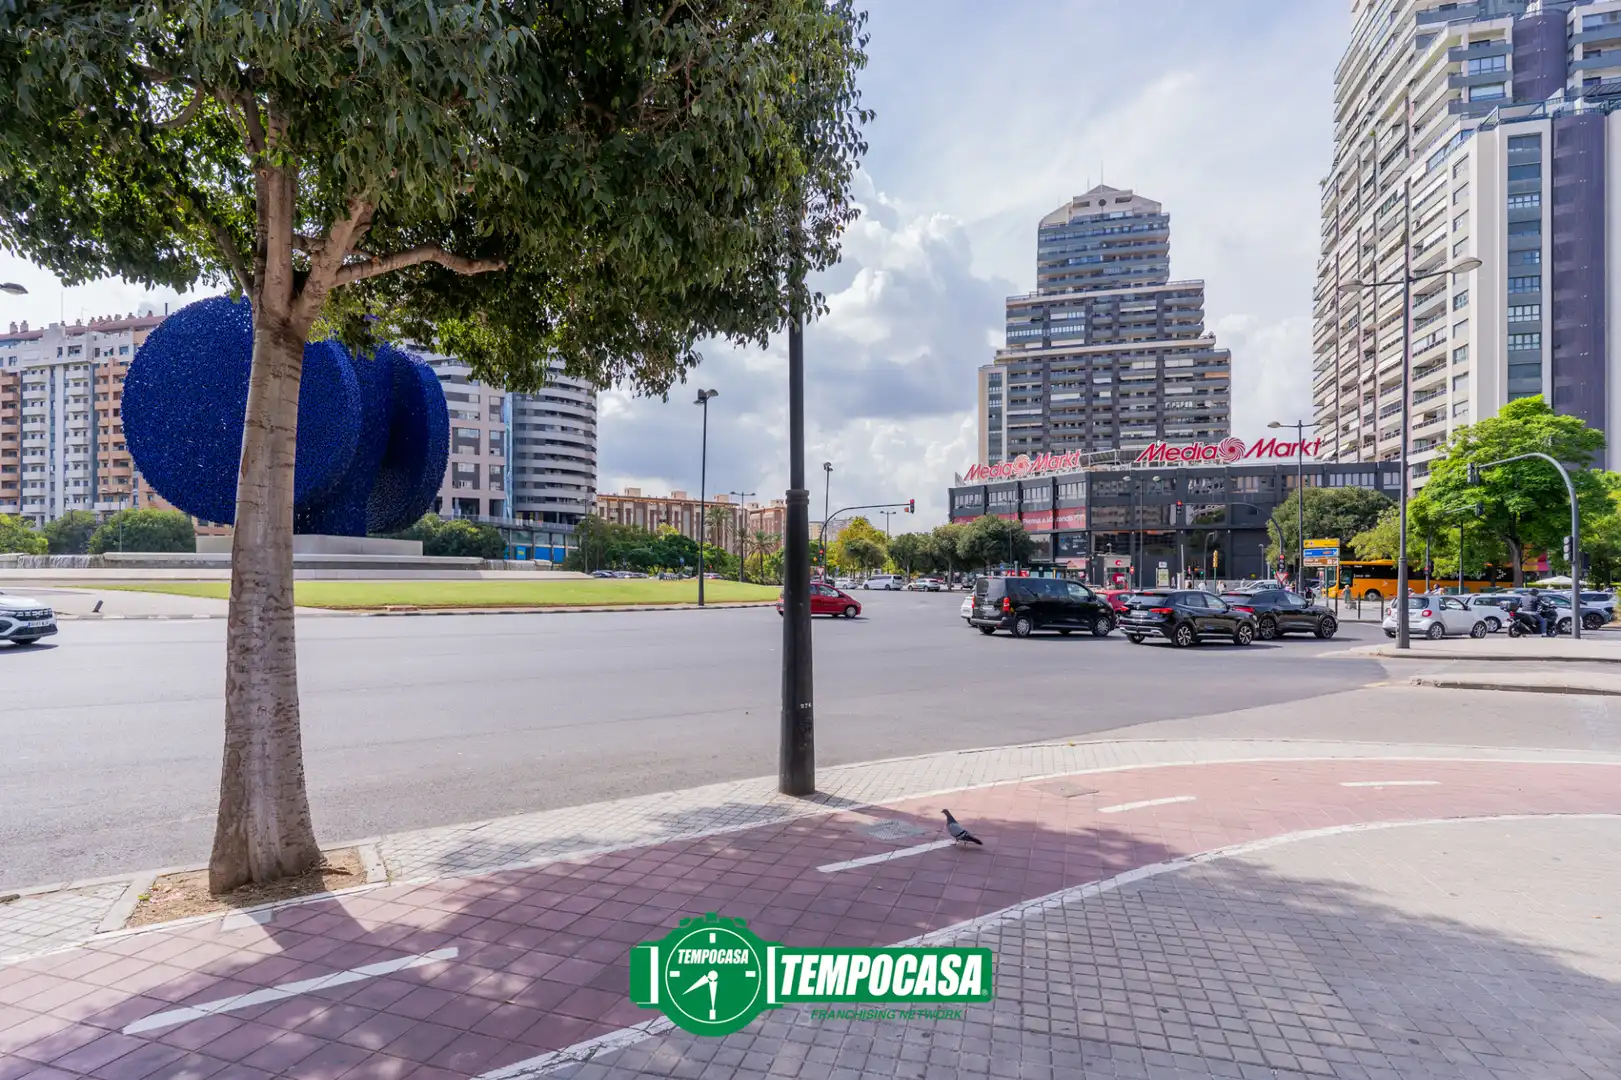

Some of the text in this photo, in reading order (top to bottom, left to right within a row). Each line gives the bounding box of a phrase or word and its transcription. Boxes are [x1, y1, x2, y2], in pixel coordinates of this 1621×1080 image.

[1136, 437, 1322, 462] Media Markt
[963, 449, 1082, 481] Media Markt
